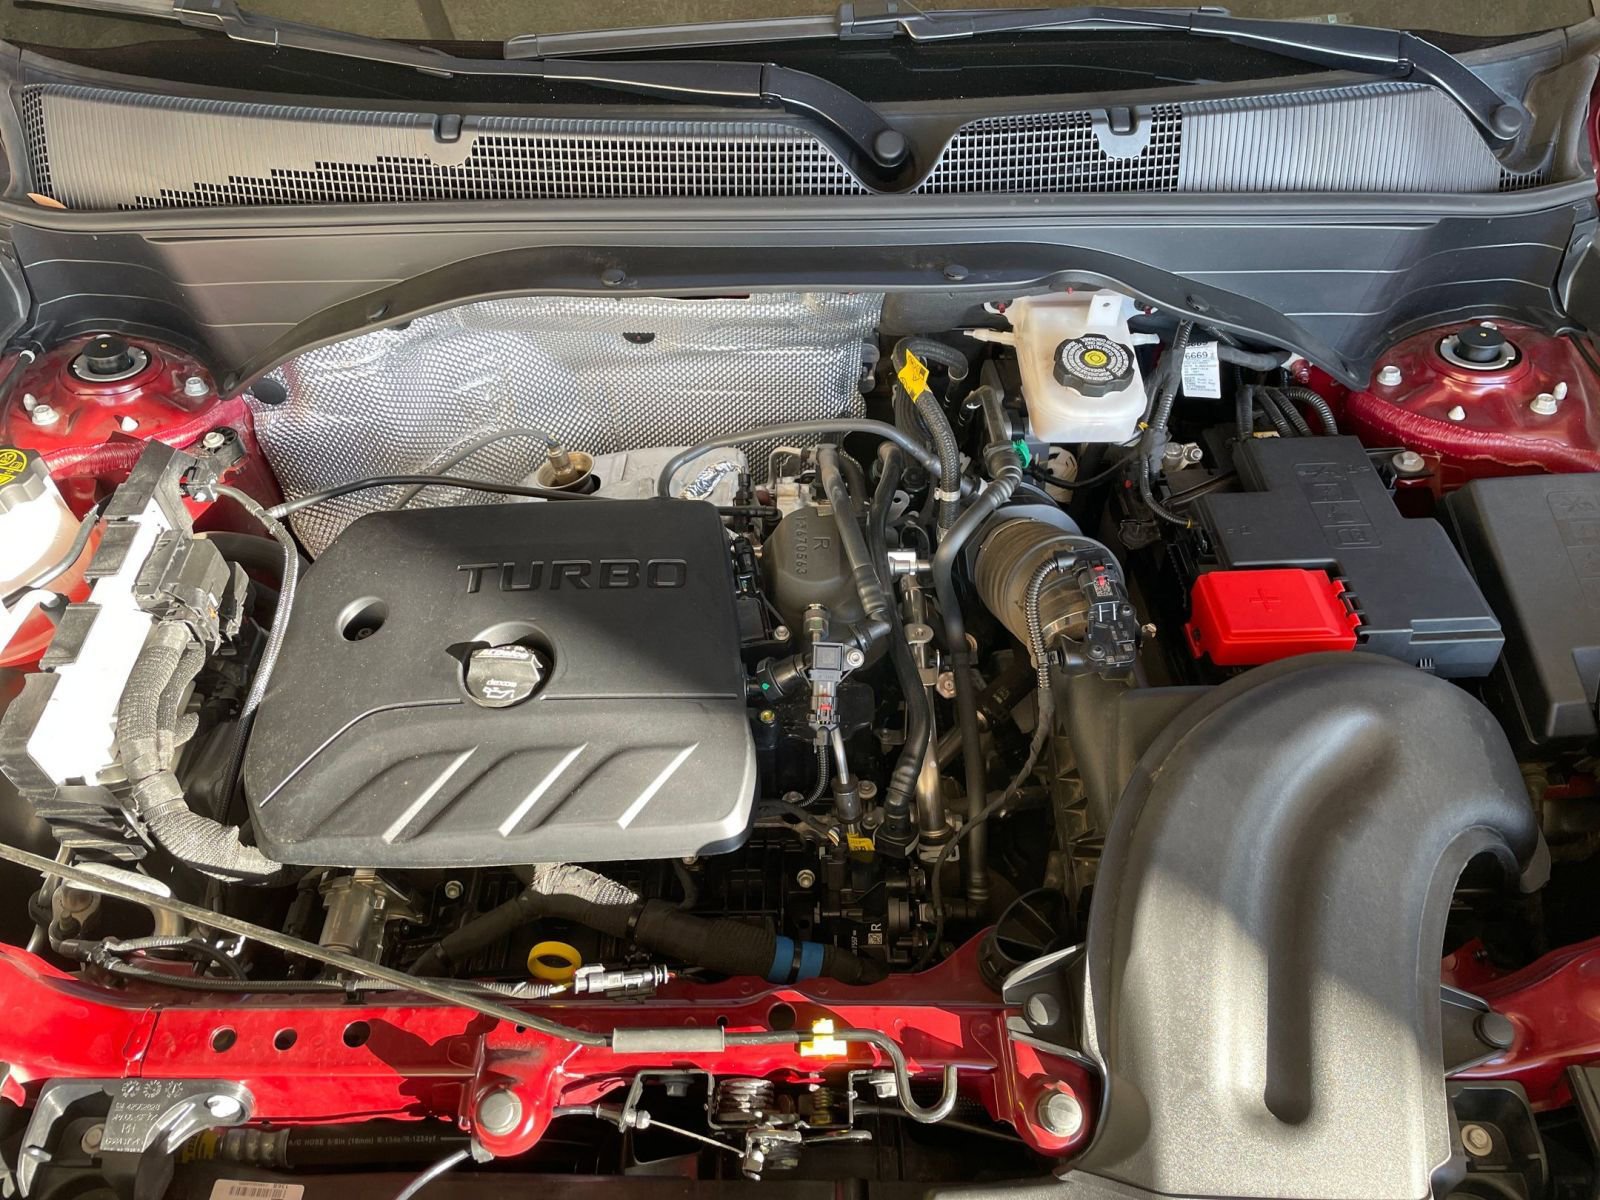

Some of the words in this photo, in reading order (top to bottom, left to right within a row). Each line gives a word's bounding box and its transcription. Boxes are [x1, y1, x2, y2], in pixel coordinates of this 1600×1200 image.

[1185, 351, 1208, 359] 6669
[813, 536, 831, 550] R
[457, 559, 687, 593] TURBO
[870, 923, 882, 931] R
